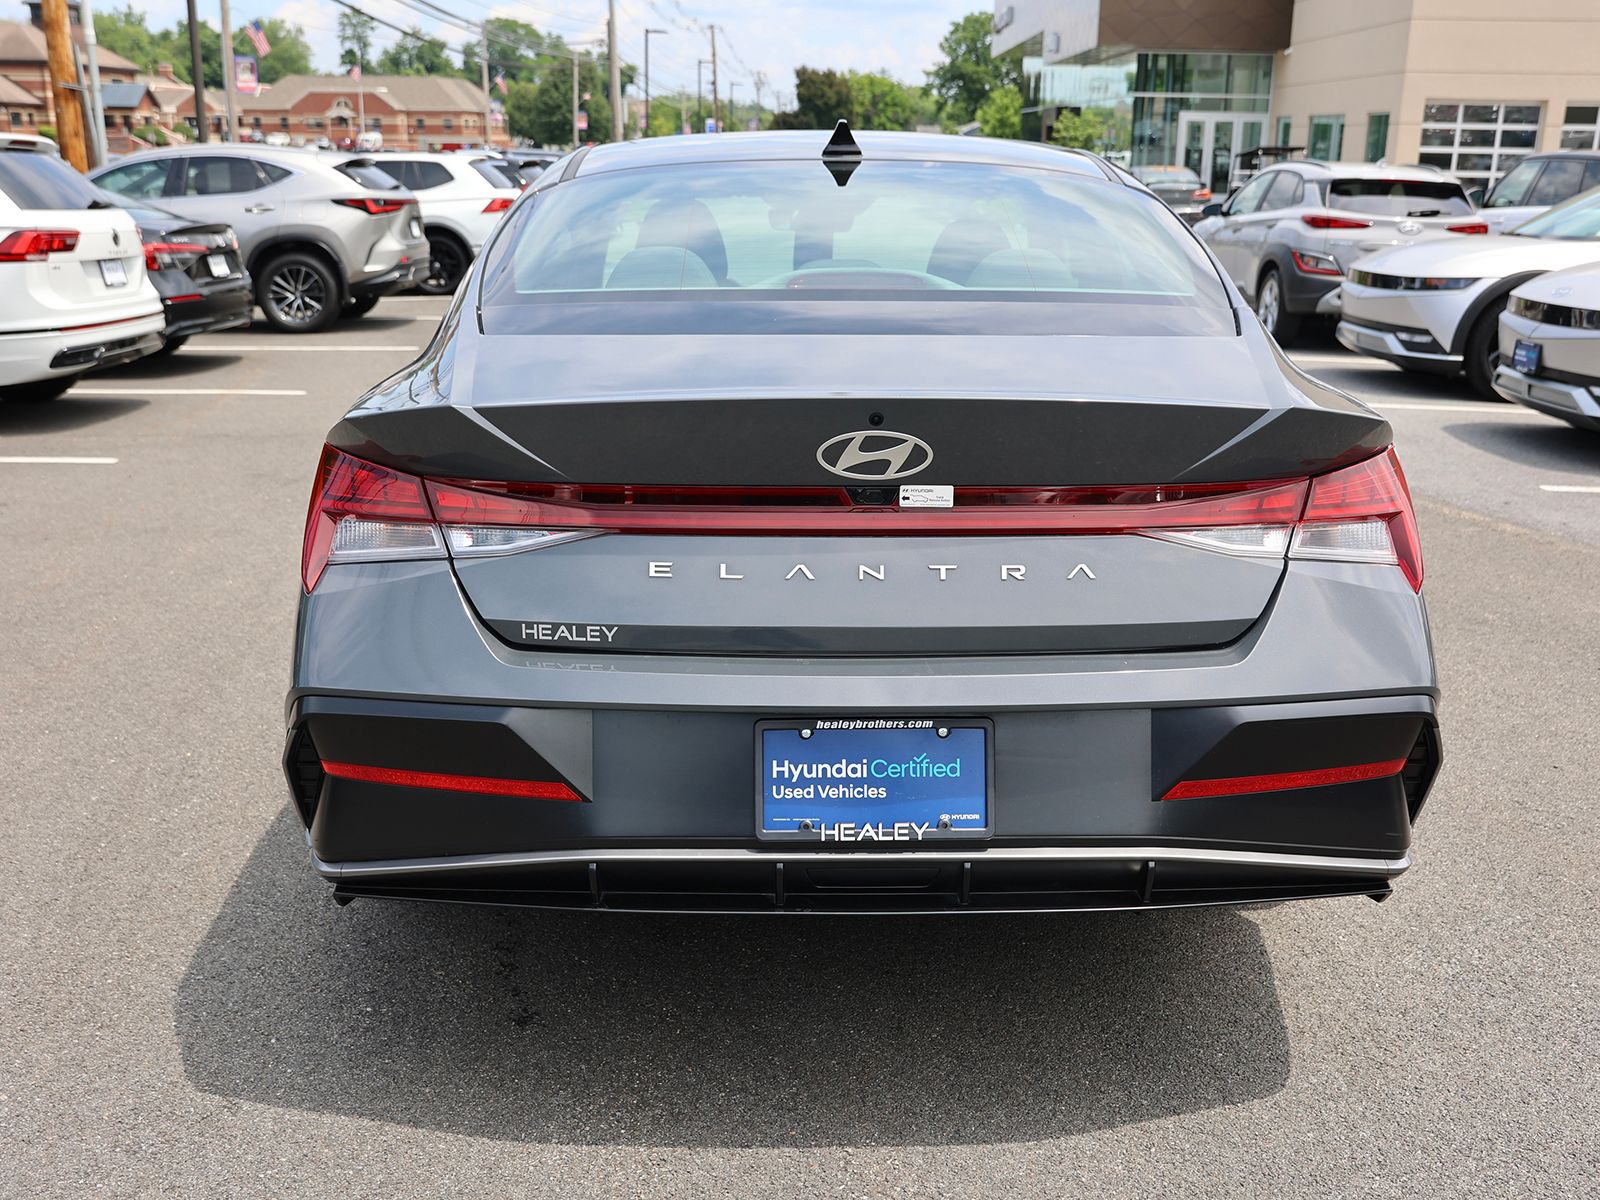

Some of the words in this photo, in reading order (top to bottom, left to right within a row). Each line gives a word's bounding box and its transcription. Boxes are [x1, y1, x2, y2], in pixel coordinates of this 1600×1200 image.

[648, 561, 1097, 581] ELANTRA
[521, 623, 619, 642] HEALEY
[816, 719, 934, 729] healeybrothers.com
[771, 759, 868, 782] Hyundai
[870, 753, 961, 778] Certified
[772, 785, 814, 799] Used
[818, 784, 887, 799] Vehicles
[820, 822, 930, 842] HEALEY
